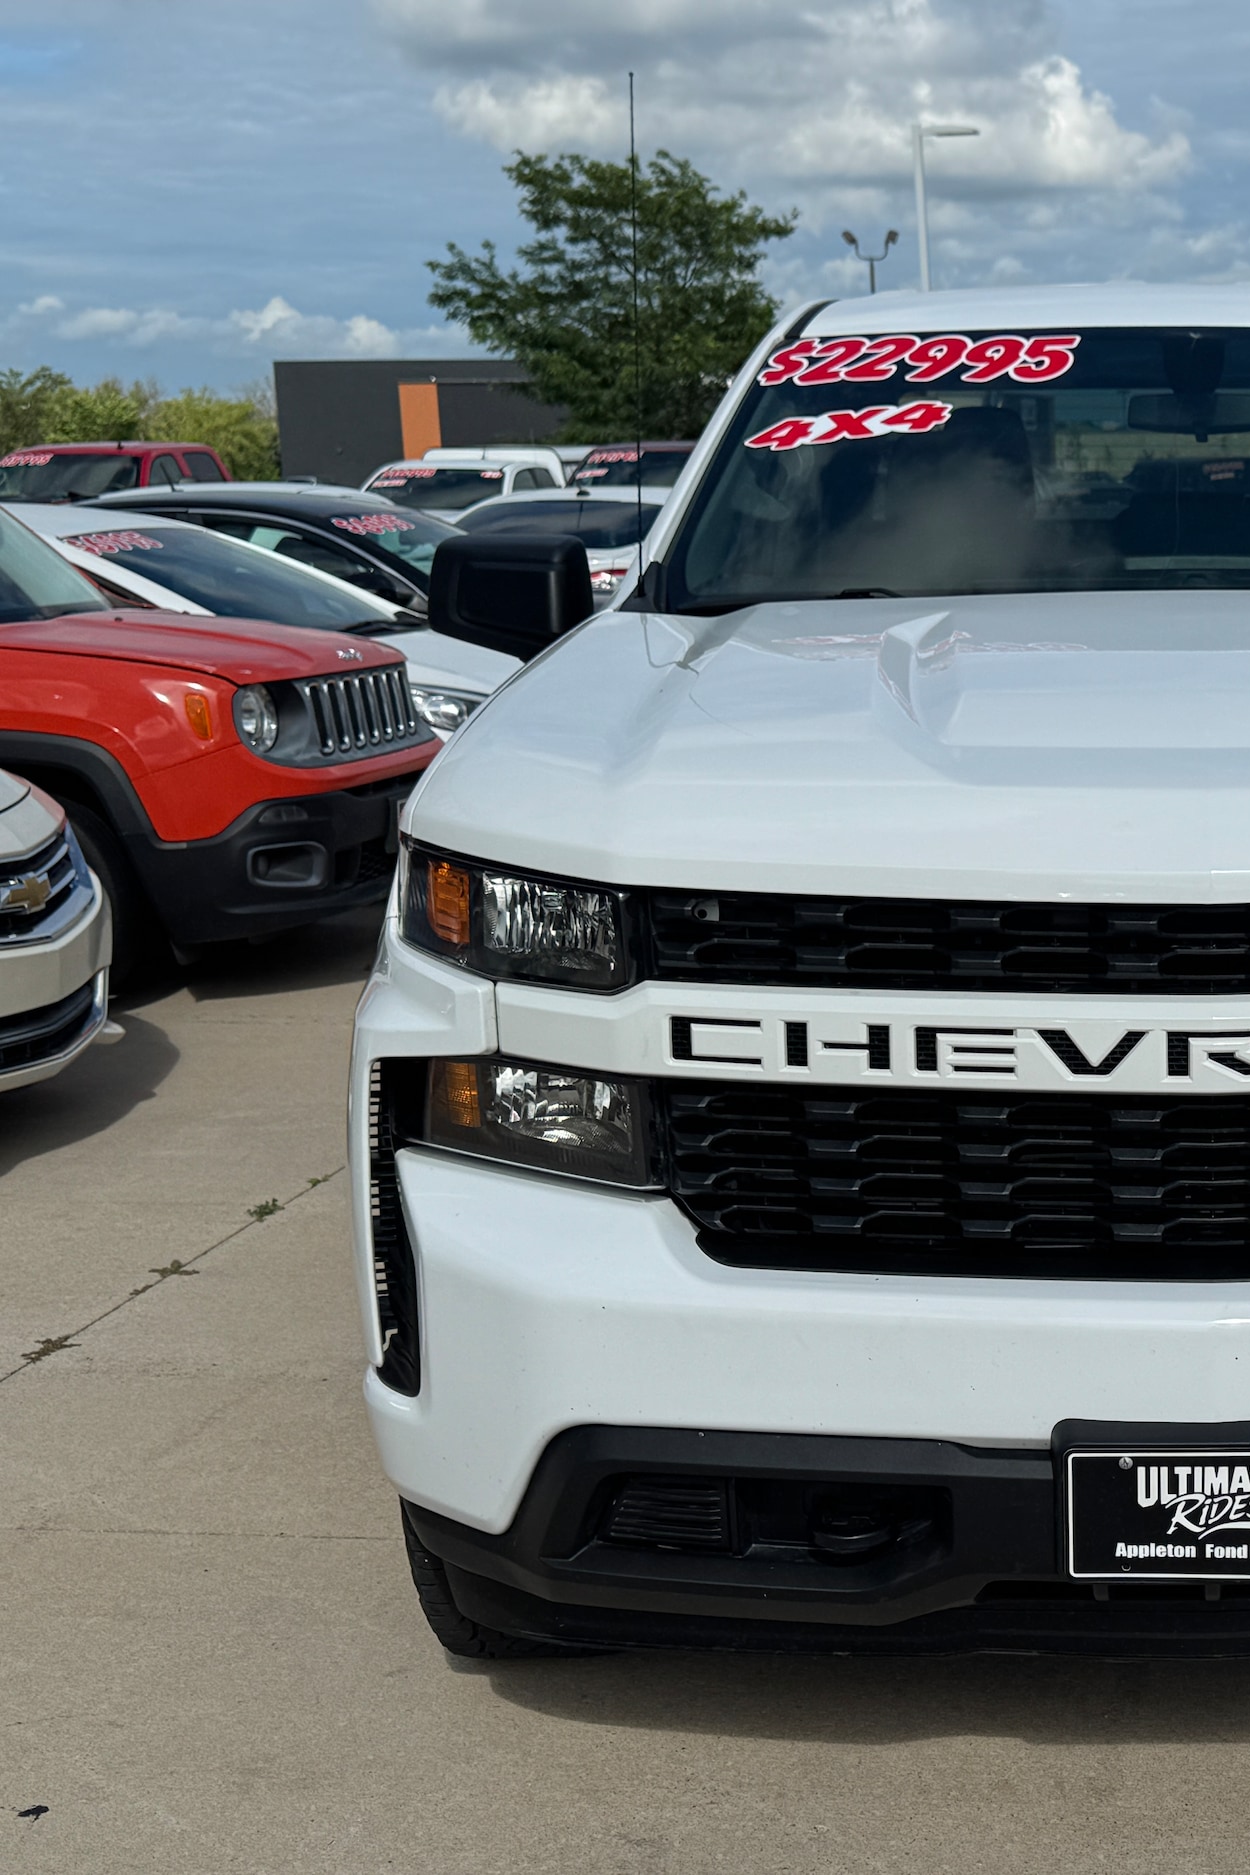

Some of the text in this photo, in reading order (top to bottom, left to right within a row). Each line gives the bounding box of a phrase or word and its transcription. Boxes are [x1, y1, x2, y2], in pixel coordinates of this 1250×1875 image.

[757, 334, 1081, 387] $22995
[1115, 1542, 1196, 1559] Appleton
[1205, 1543, 1249, 1560] Fond
